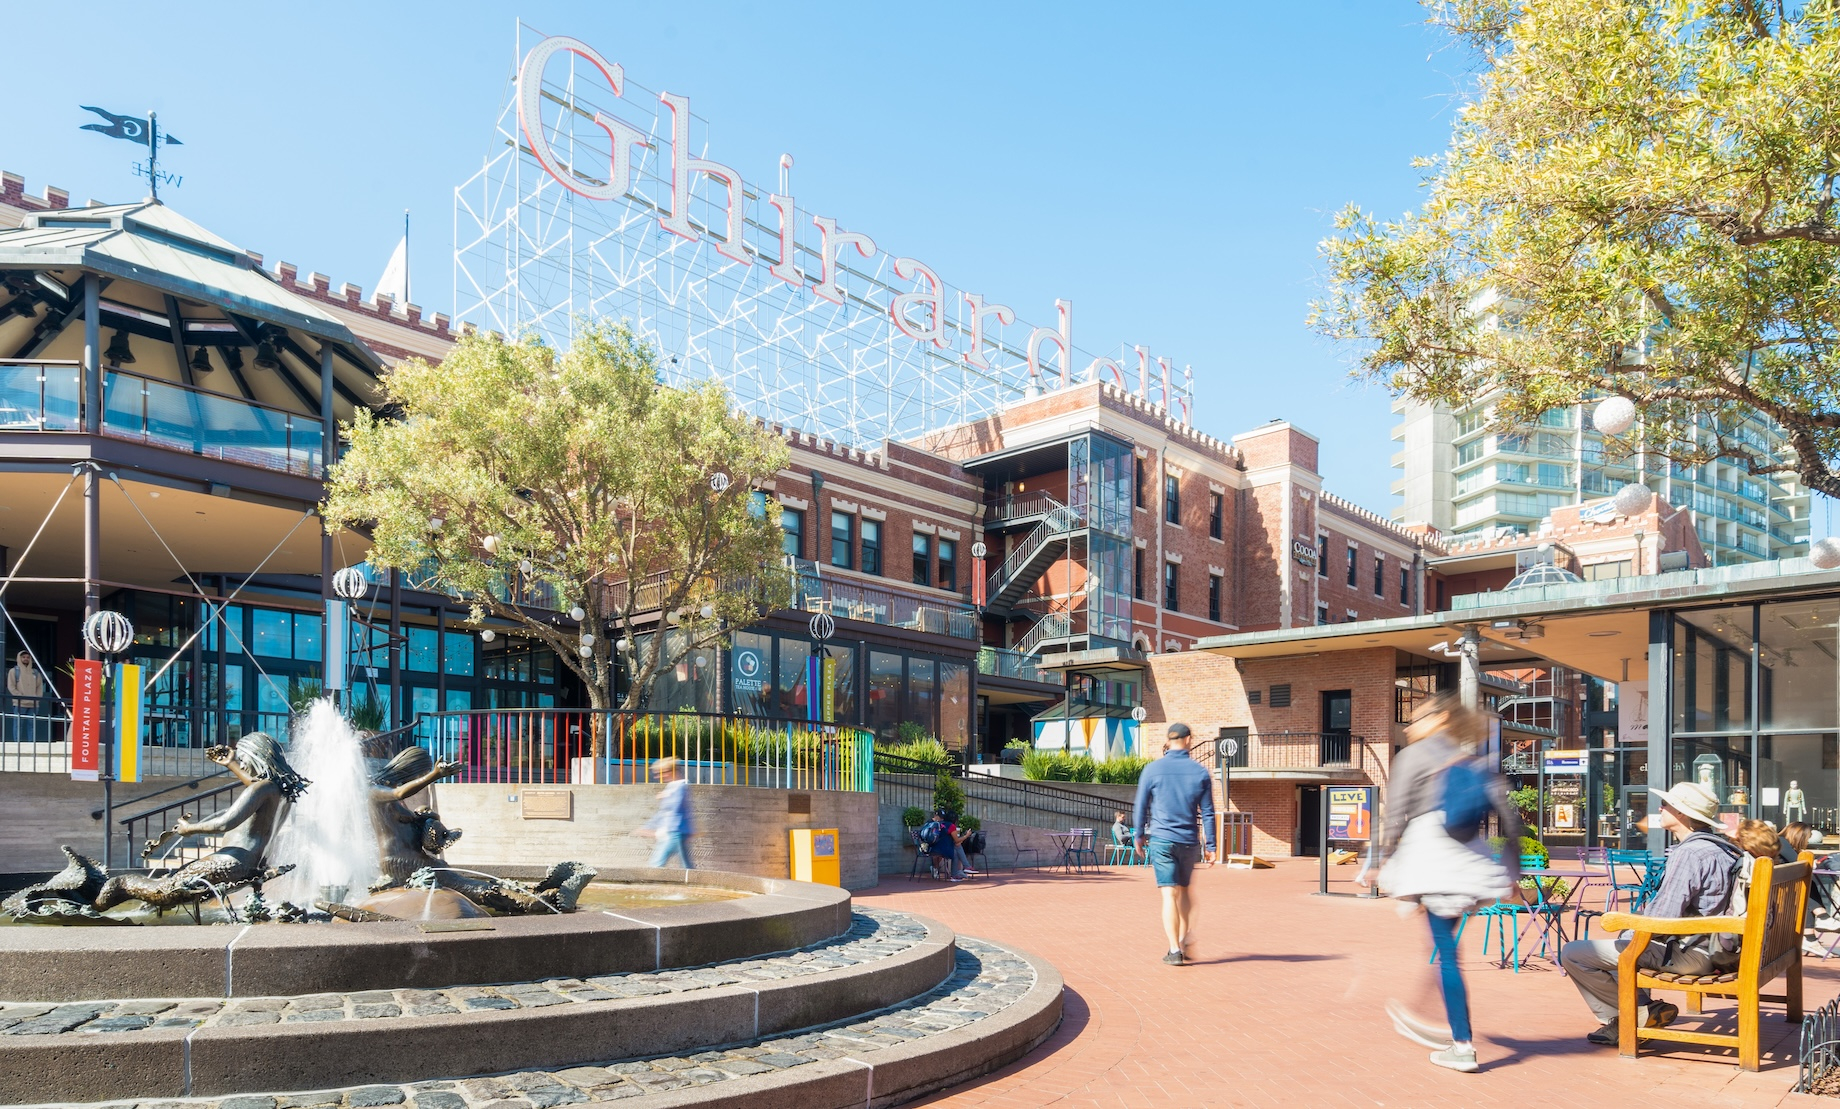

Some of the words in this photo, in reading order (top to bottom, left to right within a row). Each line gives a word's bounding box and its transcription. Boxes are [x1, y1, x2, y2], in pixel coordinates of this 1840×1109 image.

[83, 667, 93, 702] PLAZA
[735, 677, 762, 687] PALETTE
[82, 706, 91, 763] FOUNTAIN
[1333, 793, 1364, 802] LIVE
